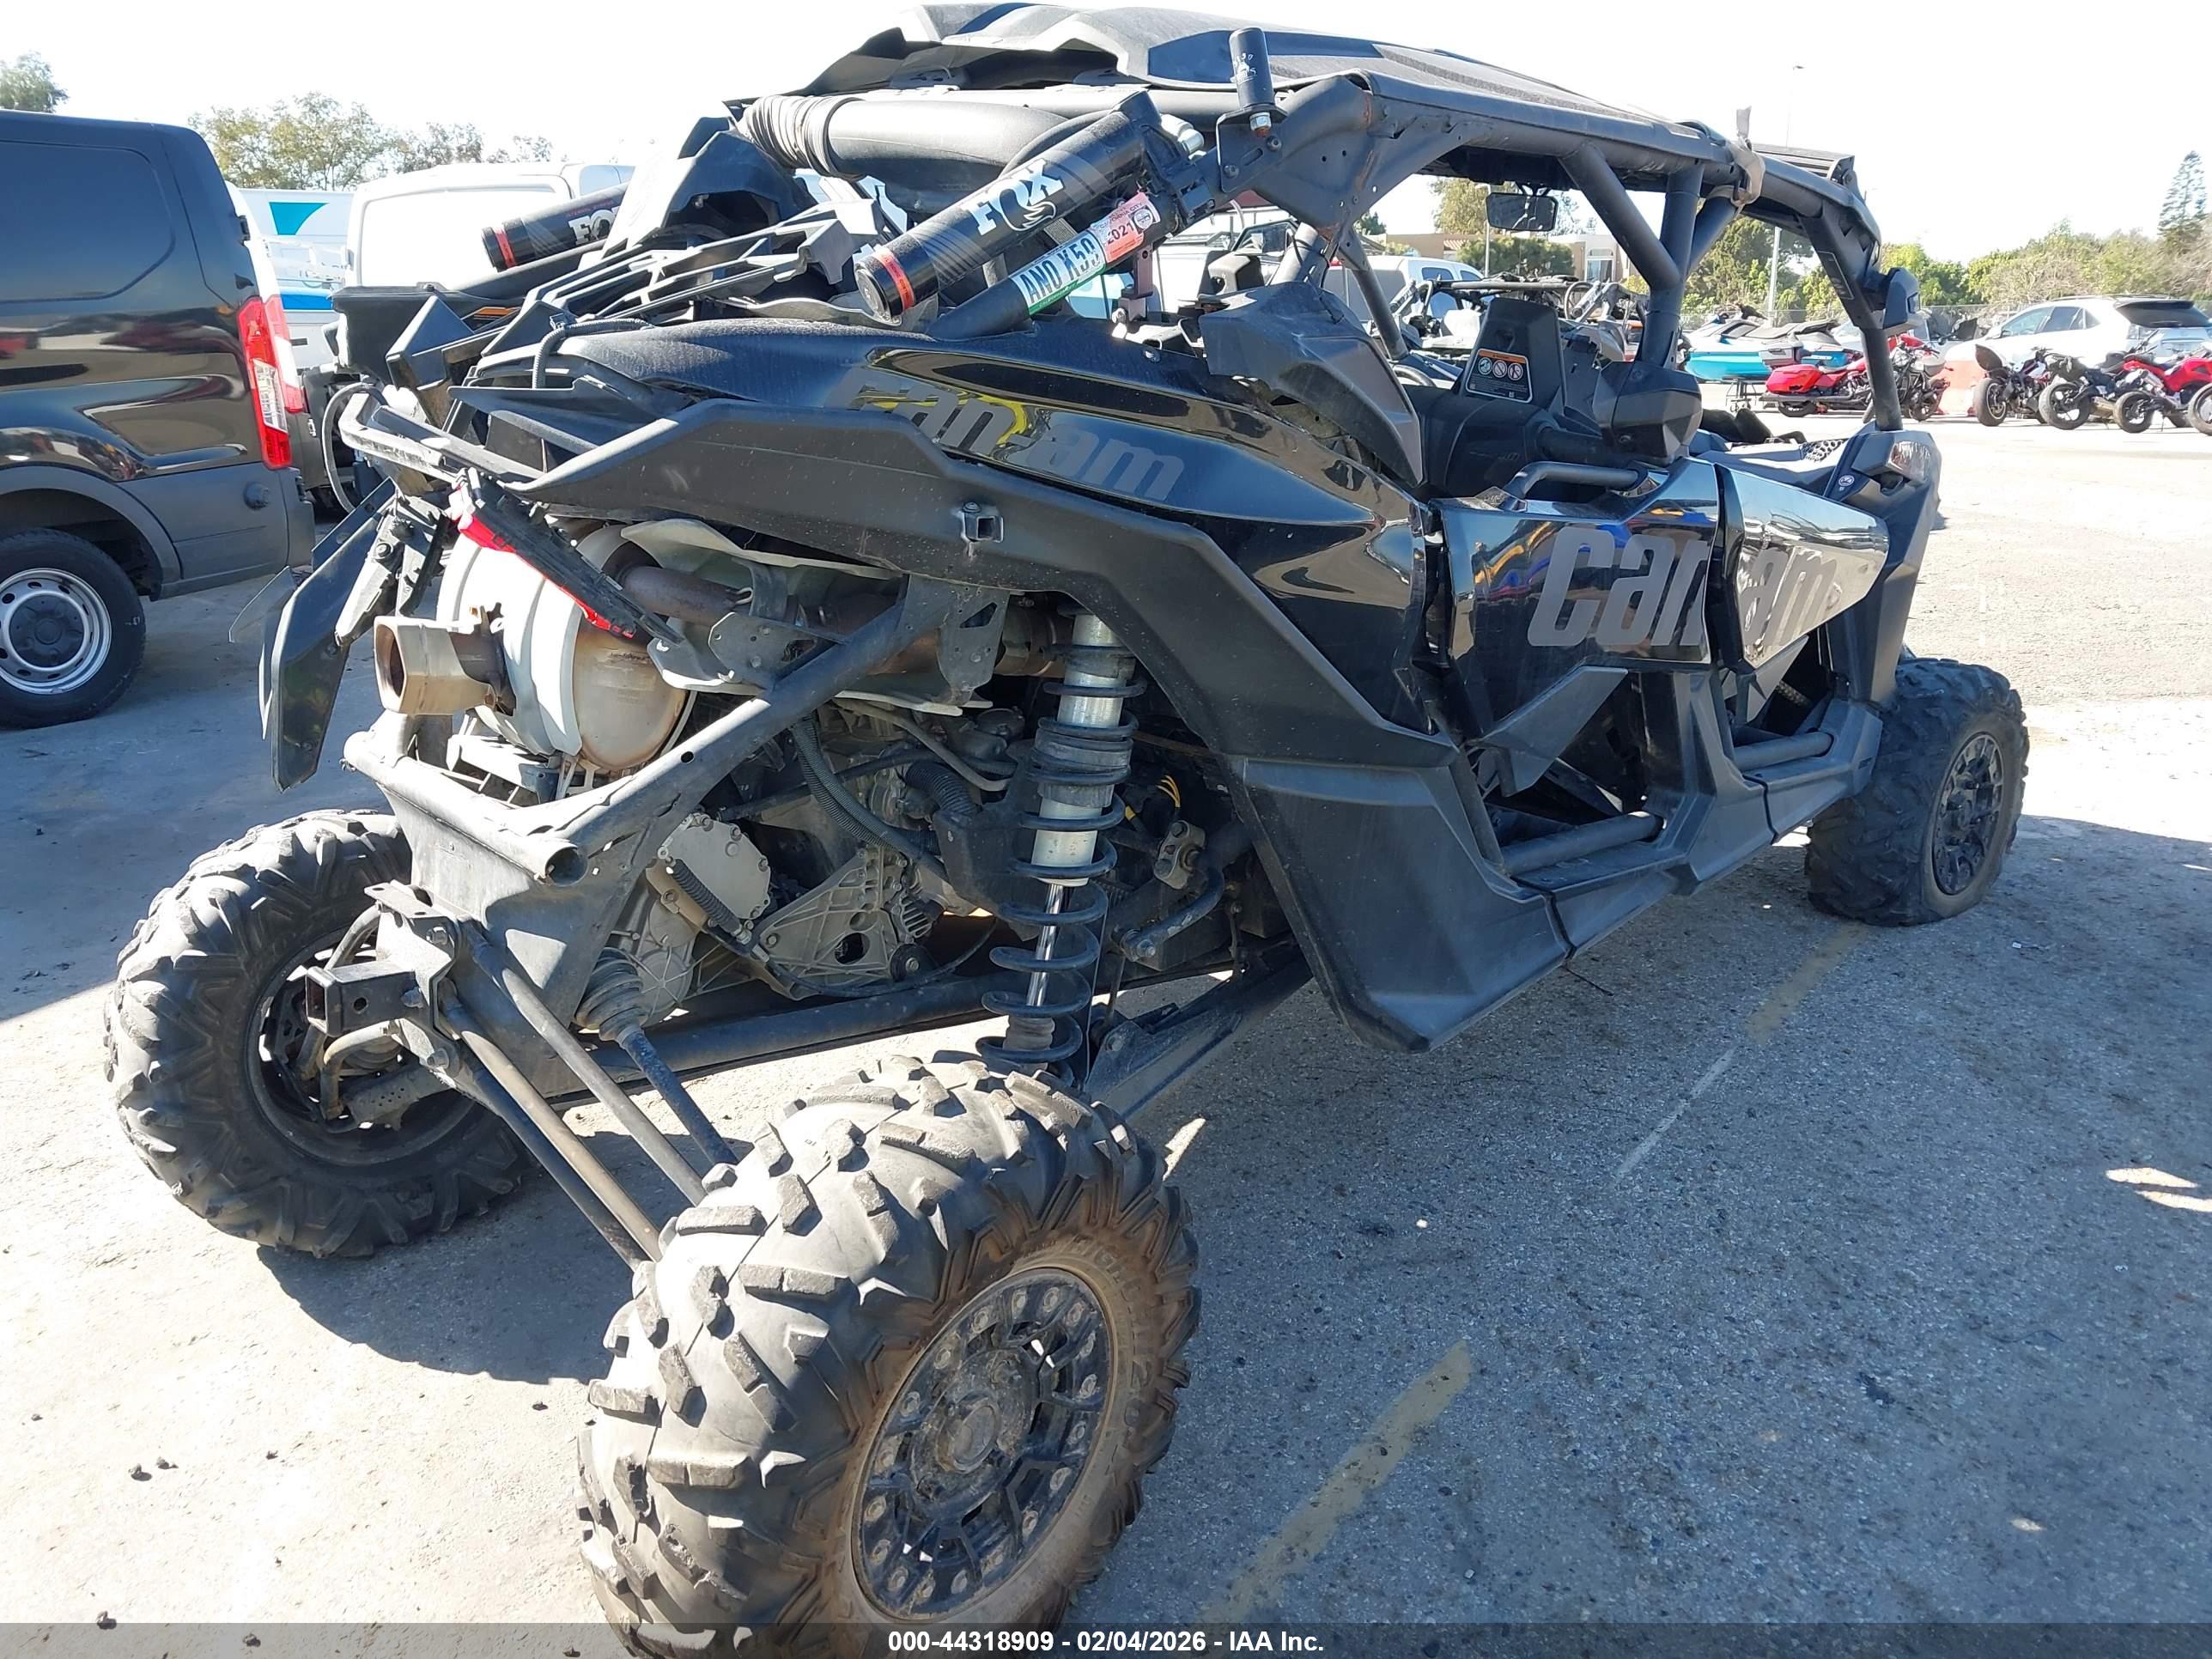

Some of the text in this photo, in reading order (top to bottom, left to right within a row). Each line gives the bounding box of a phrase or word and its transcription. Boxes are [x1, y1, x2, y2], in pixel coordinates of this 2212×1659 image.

[959, 158, 1064, 236] FOX
[568, 206, 620, 246] FO
[1108, 222, 1134, 245] 2021
